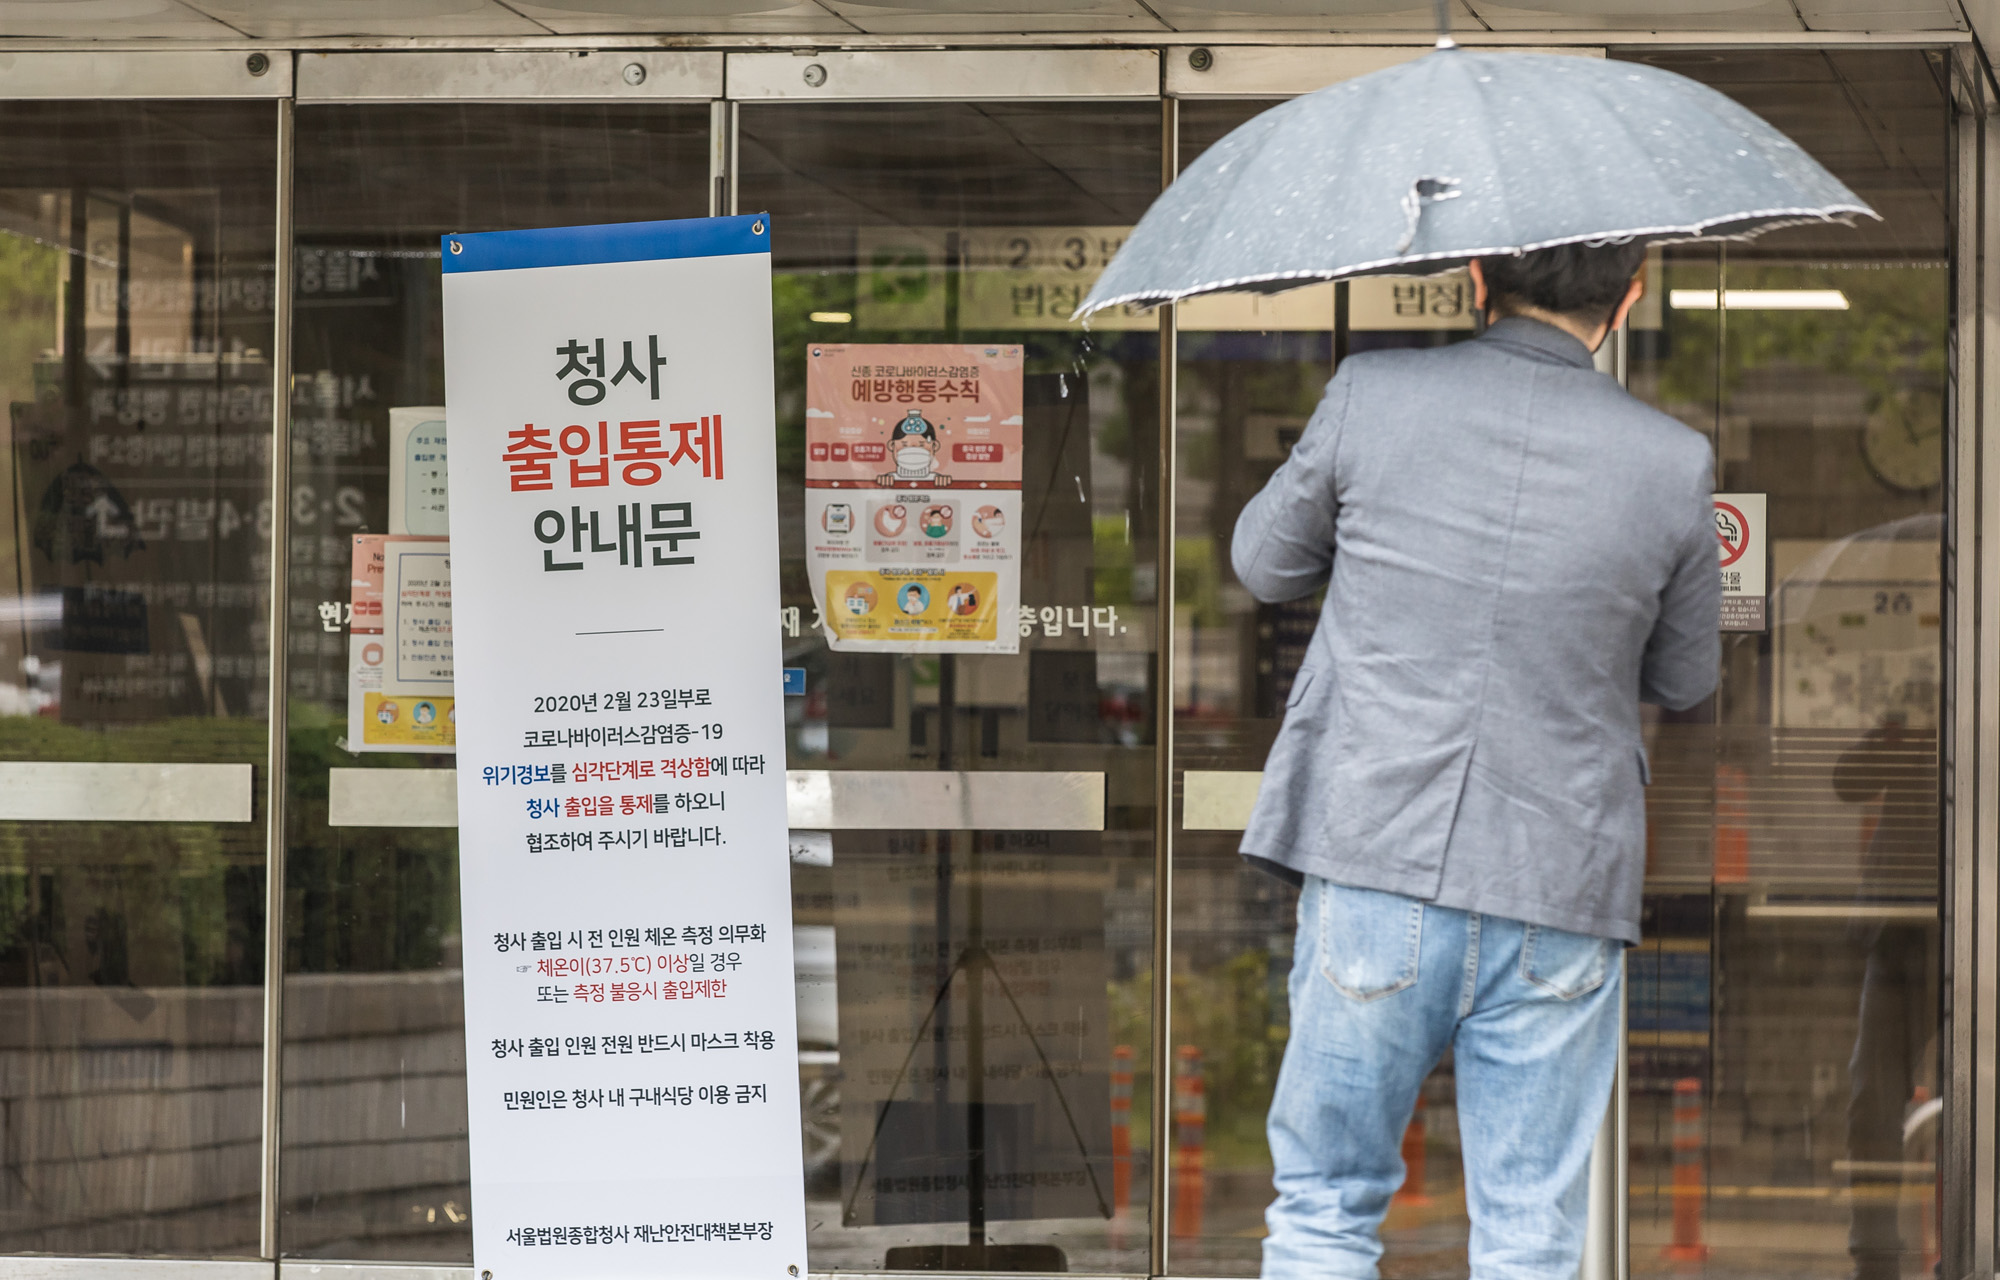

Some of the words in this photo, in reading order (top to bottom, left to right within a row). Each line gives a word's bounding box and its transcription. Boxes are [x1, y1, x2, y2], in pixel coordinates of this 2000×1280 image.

[1064, 237, 1085, 270] 3
[1393, 283, 1473, 317] 법정
[556, 335, 667, 406] 청사
[851, 365, 872, 378] 신종
[875, 365, 980, 378] 코로나바이러스감염증
[851, 379, 980, 403] 예방행동수칙
[502, 417, 723, 492] 출입통제
[534, 502, 700, 572] 안내문
[534, 692, 597, 713] 2020년
[604, 690, 631, 711] 2월
[637, 688, 712, 709] 23일부로
[524, 723, 723, 749] 코로나바이러스감염증-19
[482, 763, 567, 787] 위기경보를
[571, 758, 656, 783] 심각단계로
[660, 755, 728, 779] 격상함에
[732, 754, 765, 776] 따라
[526, 798, 560, 819] 청사
[564, 795, 615, 818] 출입을
[619, 793, 670, 815] 통제를
[674, 791, 725, 812] 하오니
[526, 831, 592, 853] 협조하여
[598, 829, 648, 850] 주시기
[654, 826, 726, 848] 바랍니다.
[494, 932, 526, 952] 청사
[531, 931, 561, 951] 출입
[568, 930, 583, 949] 시
[588, 929, 603, 948] 전
[608, 928, 640, 948] 인원
[645, 926, 677, 946] 체온
[681, 925, 713, 945] 측정
[718, 923, 766, 944] 의무화
[537, 955, 652, 978] 체온이(37.5℃)
[657, 952, 705, 973] 이상일
[710, 952, 743, 972] 경우
[537, 985, 569, 1003] 또는
[573, 983, 605, 1003] 측정
[610, 981, 657, 1001] 불응시
[662, 979, 727, 1000] 출입제한
[491, 1038, 524, 1059] 청사
[528, 1037, 560, 1058] 출입
[565, 1036, 596, 1055] 인원
[601, 1035, 632, 1054] 전원
[638, 1033, 685, 1053] 반드시
[691, 1033, 739, 1051] 마스크
[743, 1031, 775, 1051] 착용
[504, 1089, 568, 1110] 민원인은
[572, 1088, 604, 1109] 청사
[609, 1088, 624, 1107] 내
[629, 1086, 694, 1106] 구내식당
[699, 1085, 730, 1104] 이용
[735, 1084, 766, 1103] 금지
[506, 1226, 630, 1247] 서울법원종합청사
[633, 1221, 774, 1244] 재난안전대책본부장
